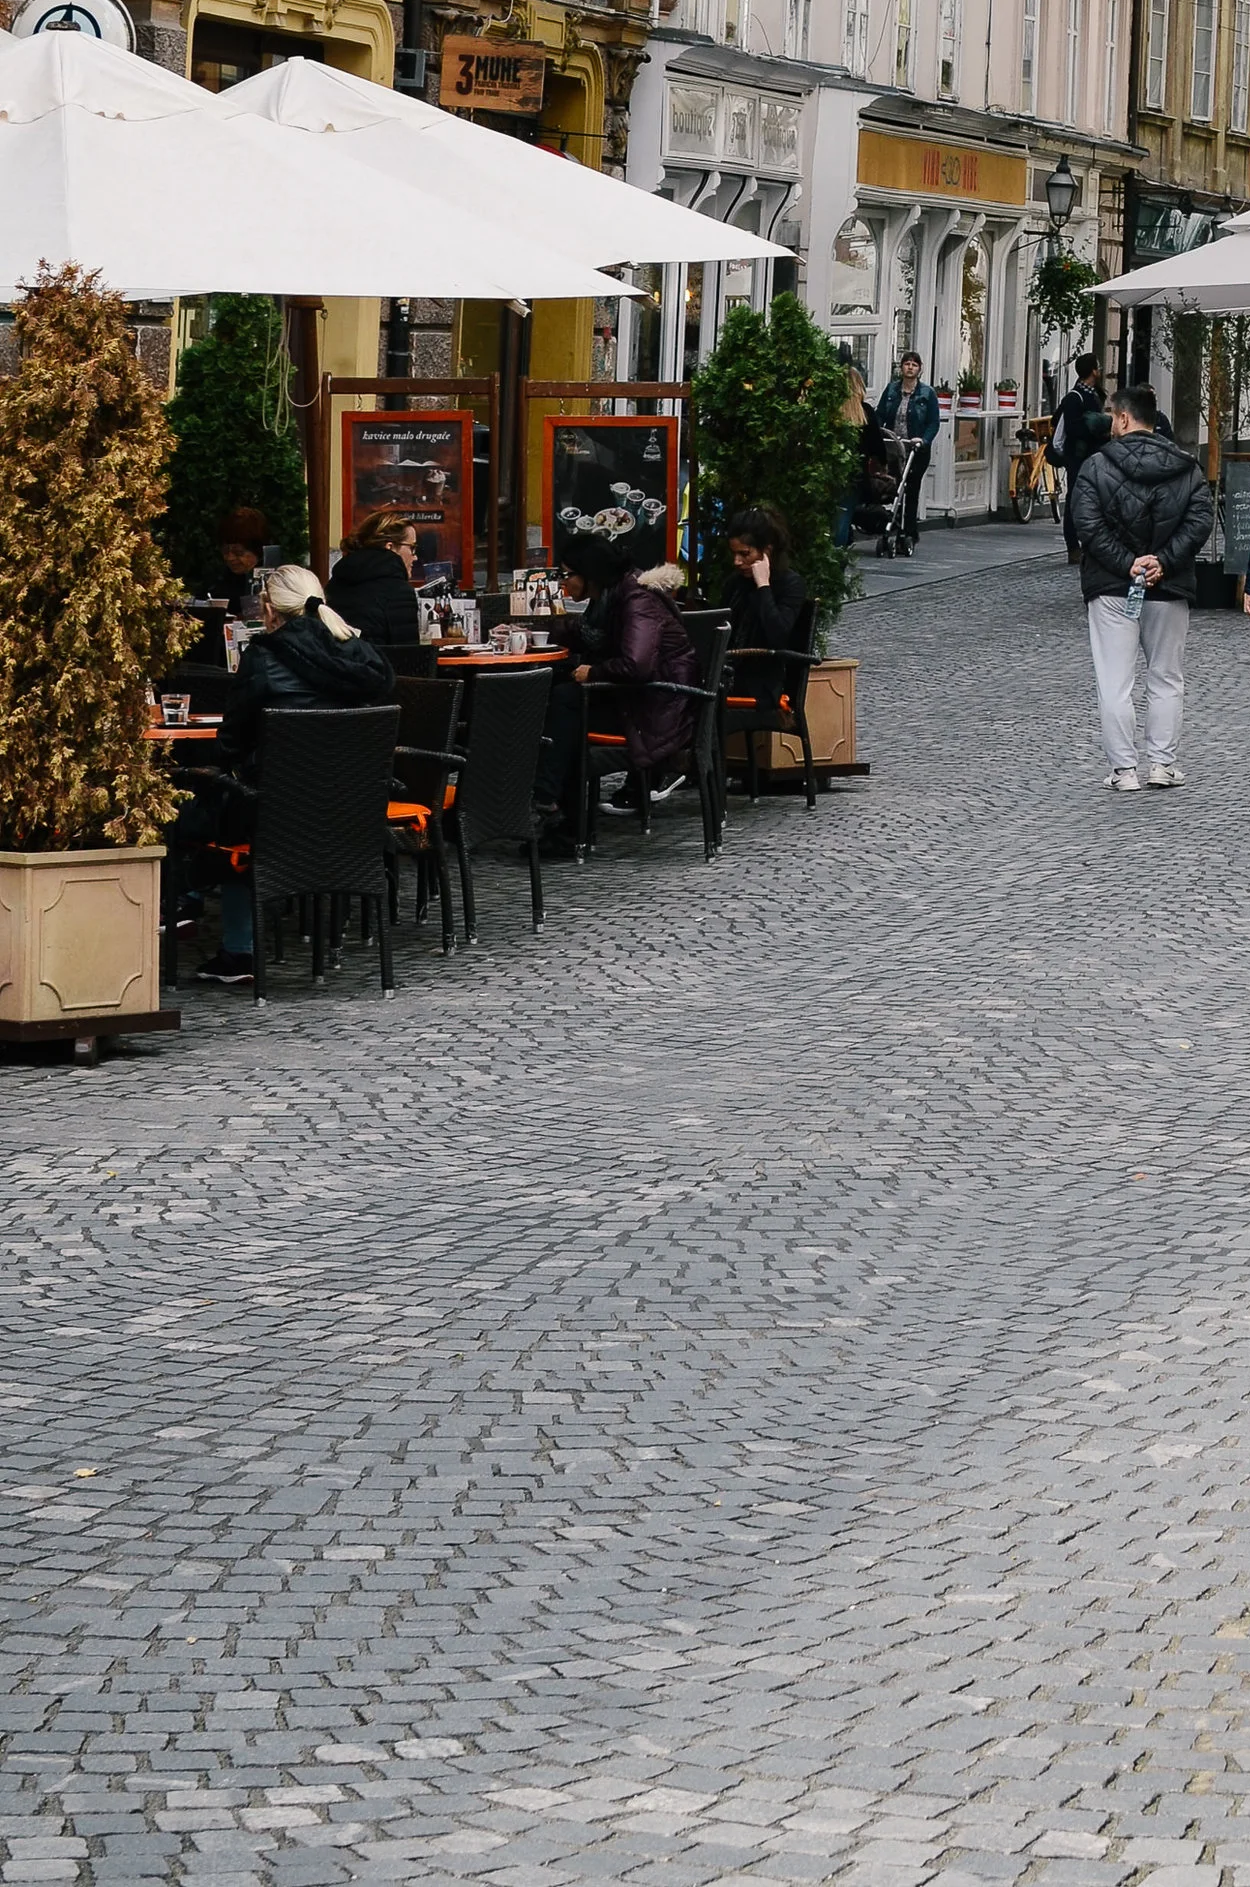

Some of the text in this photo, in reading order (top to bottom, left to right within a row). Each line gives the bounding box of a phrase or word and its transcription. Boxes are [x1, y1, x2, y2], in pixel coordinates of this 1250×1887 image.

[456, 54, 521, 95] 3 MUHE
[672, 103, 713, 143] boutique
[362, 430, 391, 441] kavice
[393, 430, 414, 441] malo
